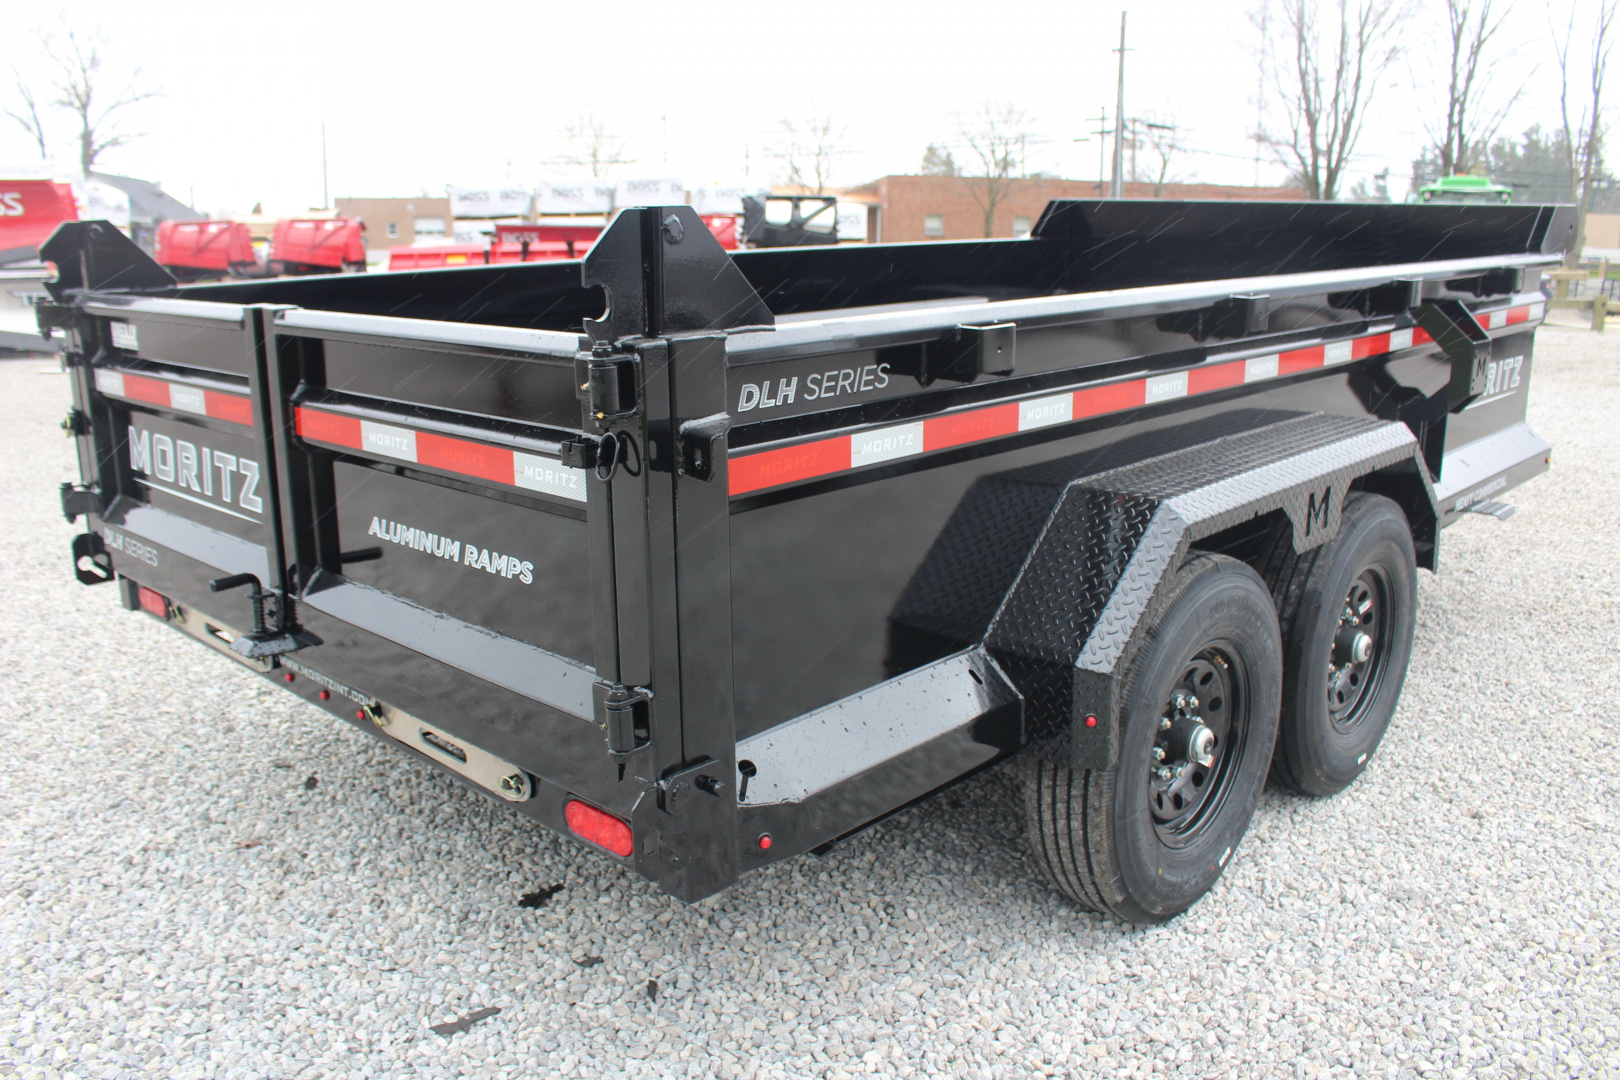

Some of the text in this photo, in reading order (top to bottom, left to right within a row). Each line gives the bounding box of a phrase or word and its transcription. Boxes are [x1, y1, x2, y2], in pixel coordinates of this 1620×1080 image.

[737, 363, 891, 413] DLH SERIES
[1151, 380, 1183, 394] MORITZ
[1026, 403, 1066, 421] MORITZ
[368, 431, 409, 451] MORITZ
[862, 433, 914, 455] MORITZ
[128, 425, 263, 514] MORITZ
[524, 465, 578, 489] MORITZ
[759, 453, 819, 477] MORITZ
[1306, 485, 1331, 538] M
[103, 527, 159, 567] DLH SERIES
[368, 516, 534, 585] ALUMINUM RAMPS
